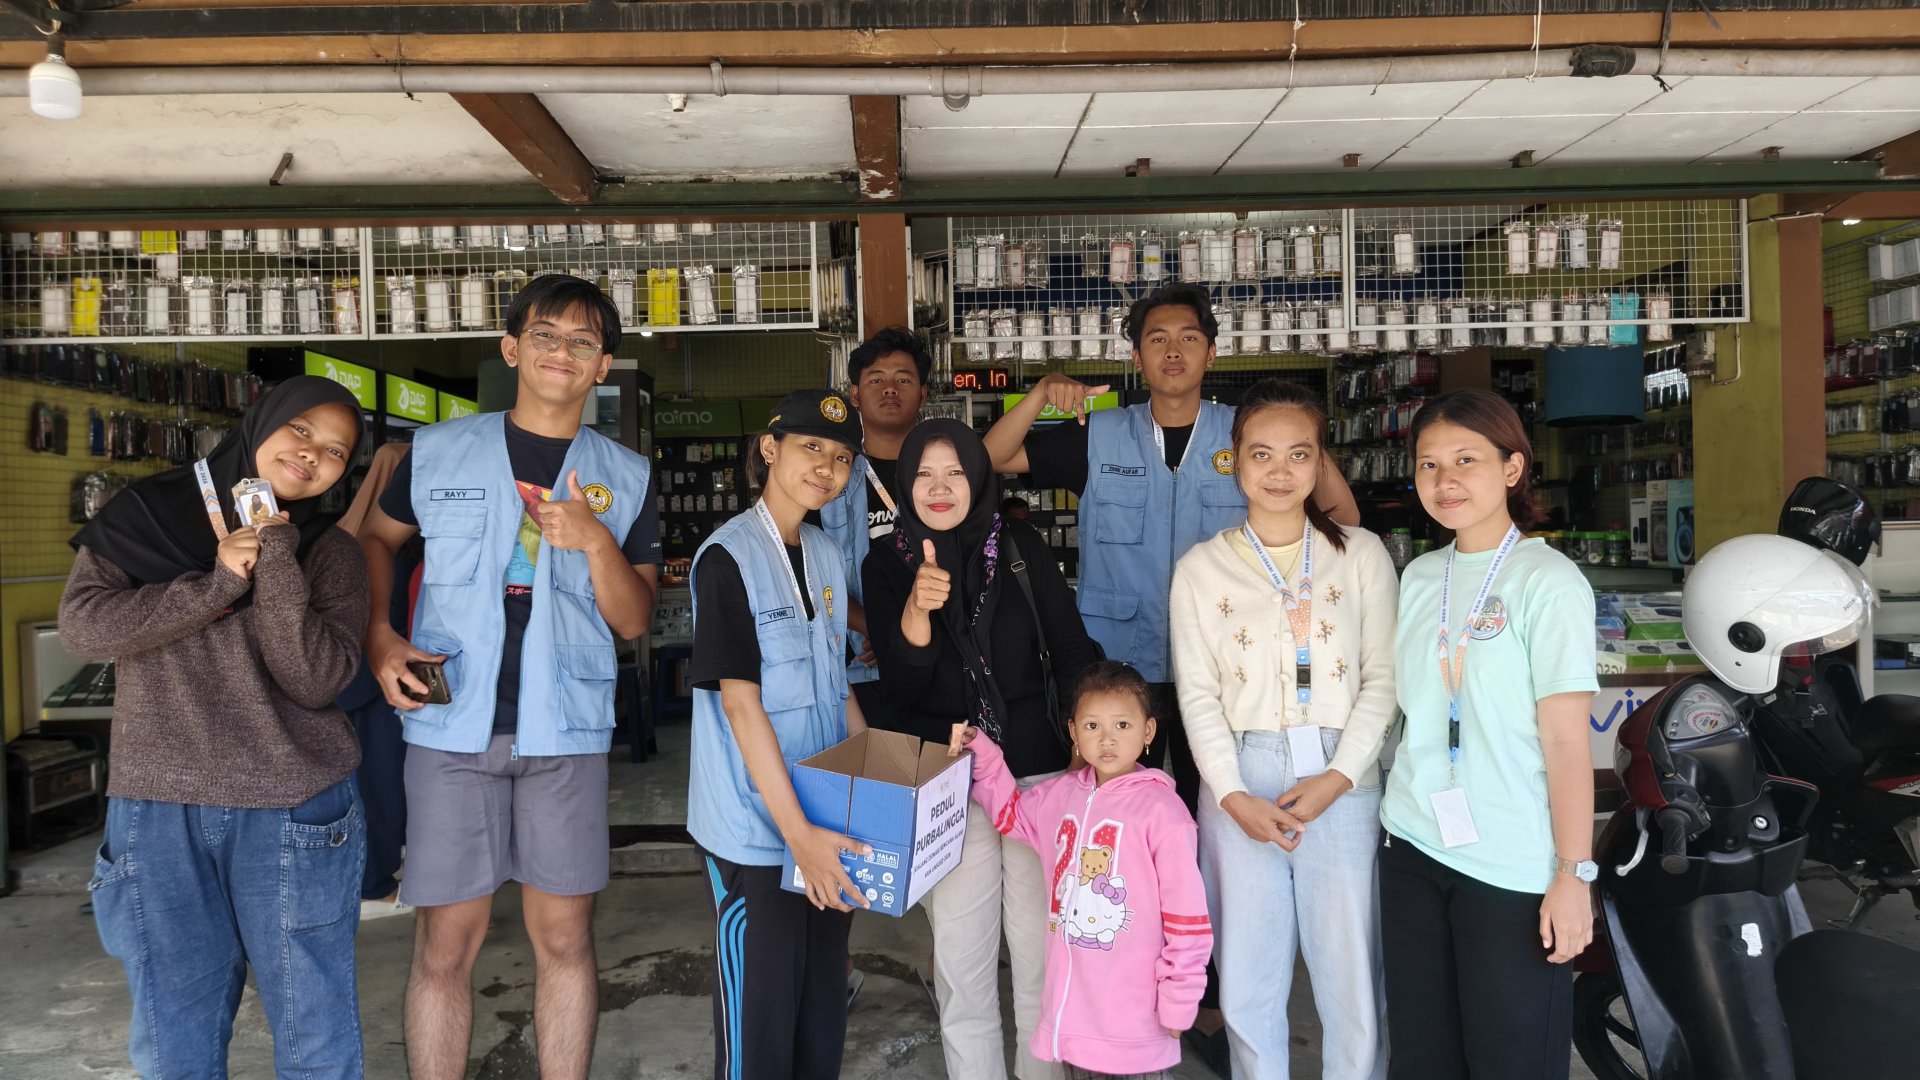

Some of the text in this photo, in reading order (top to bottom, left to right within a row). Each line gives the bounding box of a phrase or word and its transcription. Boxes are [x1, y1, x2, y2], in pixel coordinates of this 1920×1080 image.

[654, 409, 713, 424] raimo
[1790, 506, 1817, 515] HONDA
[1590, 688, 1644, 733] vi
[930, 792, 956, 822] PEDULI
[915, 806, 965, 856] PURBALINGGA
[877, 852, 897, 862] HALAL
[1050, 813, 1125, 918] 21
